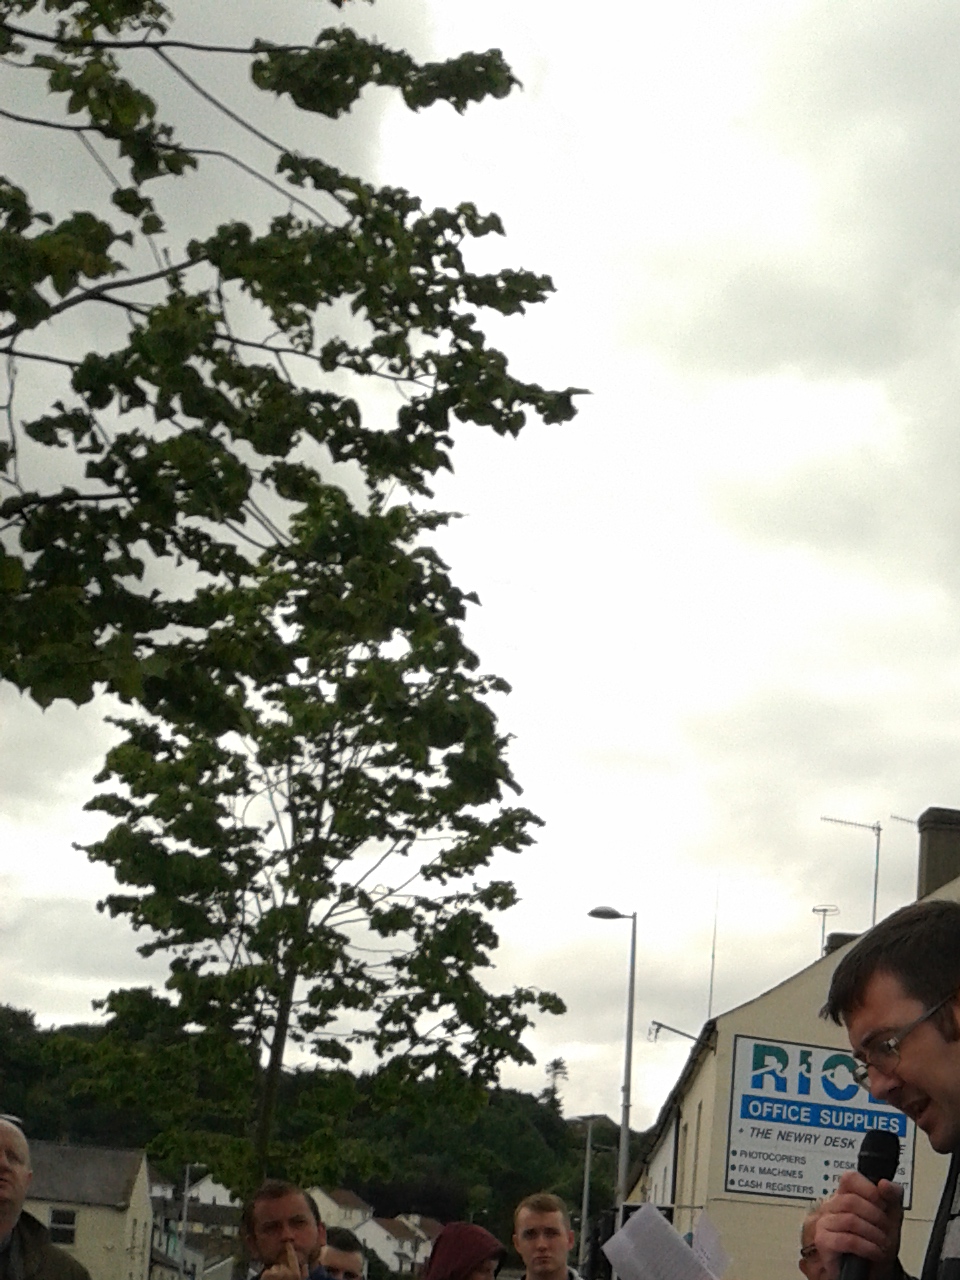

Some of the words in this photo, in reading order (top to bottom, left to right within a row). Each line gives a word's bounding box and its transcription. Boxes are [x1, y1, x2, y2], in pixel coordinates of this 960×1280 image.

[751, 1043, 888, 1104] RIC
[749, 1100, 811, 1122] OFFICE
[819, 1109, 900, 1133] SUPPLIES
[750, 1127, 772, 1139] THE
[776, 1131, 820, 1145] NEWRY
[824, 1136, 857, 1149] DESK
[739, 1149, 807, 1165] PHOTOCOPIERS
[738, 1165, 755, 1174] FAX
[759, 1167, 804, 1179] MACHINES
[738, 1179, 762, 1189] CASH
[766, 1181, 814, 1194] REGISTERS
